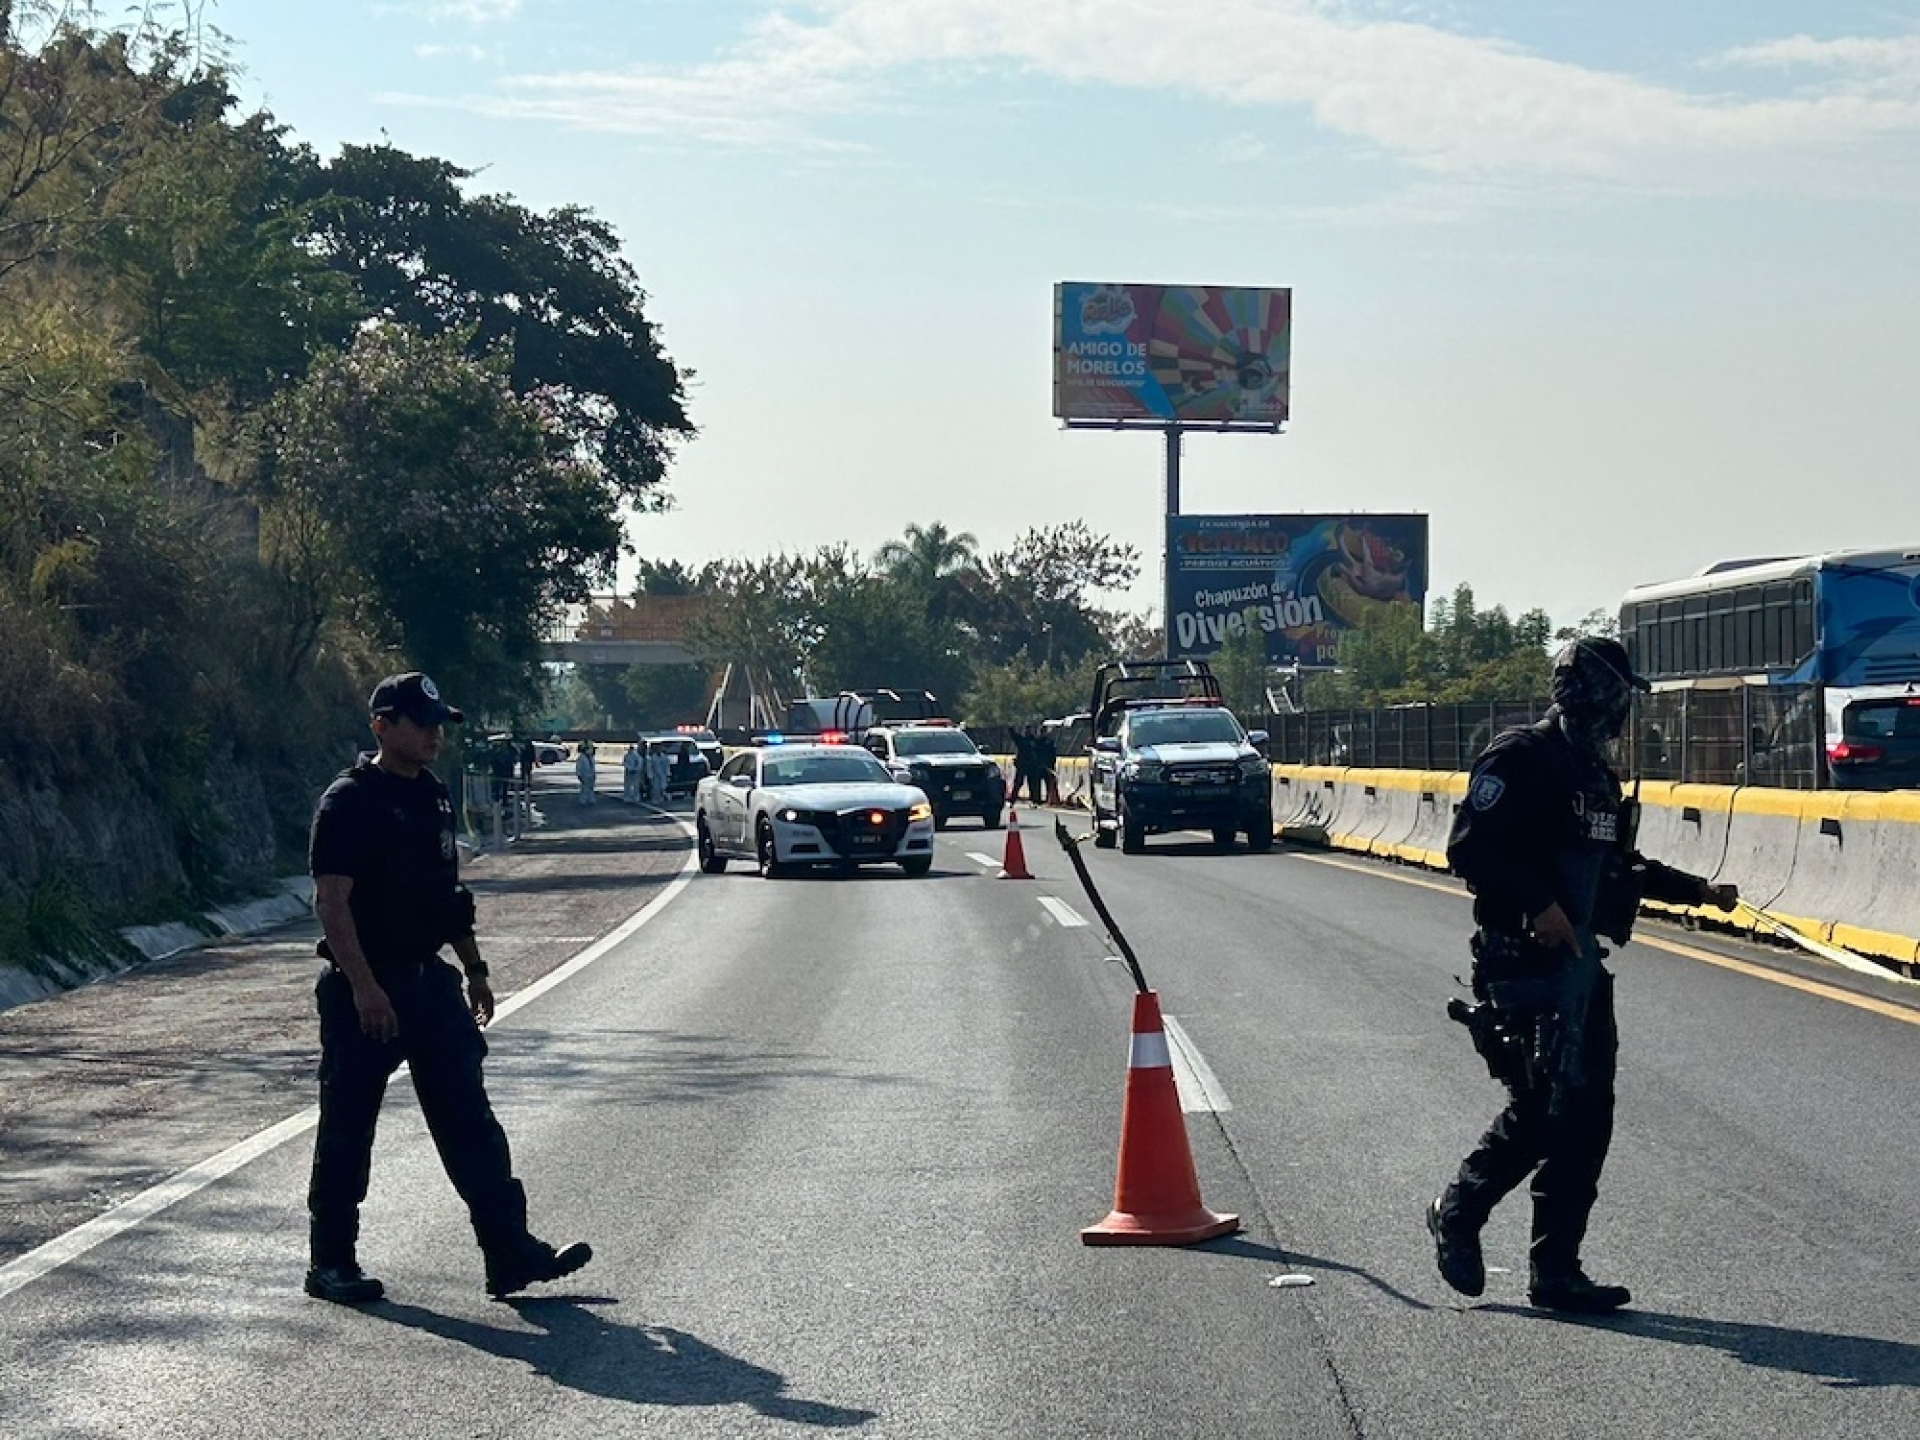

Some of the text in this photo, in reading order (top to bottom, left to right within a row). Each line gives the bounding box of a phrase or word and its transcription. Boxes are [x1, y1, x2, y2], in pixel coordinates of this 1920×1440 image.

[1067, 341, 1147, 357] AMIGO DE
[1066, 359, 1146, 375] MORELOS
[1195, 578, 1287, 608] Chapuzón de
